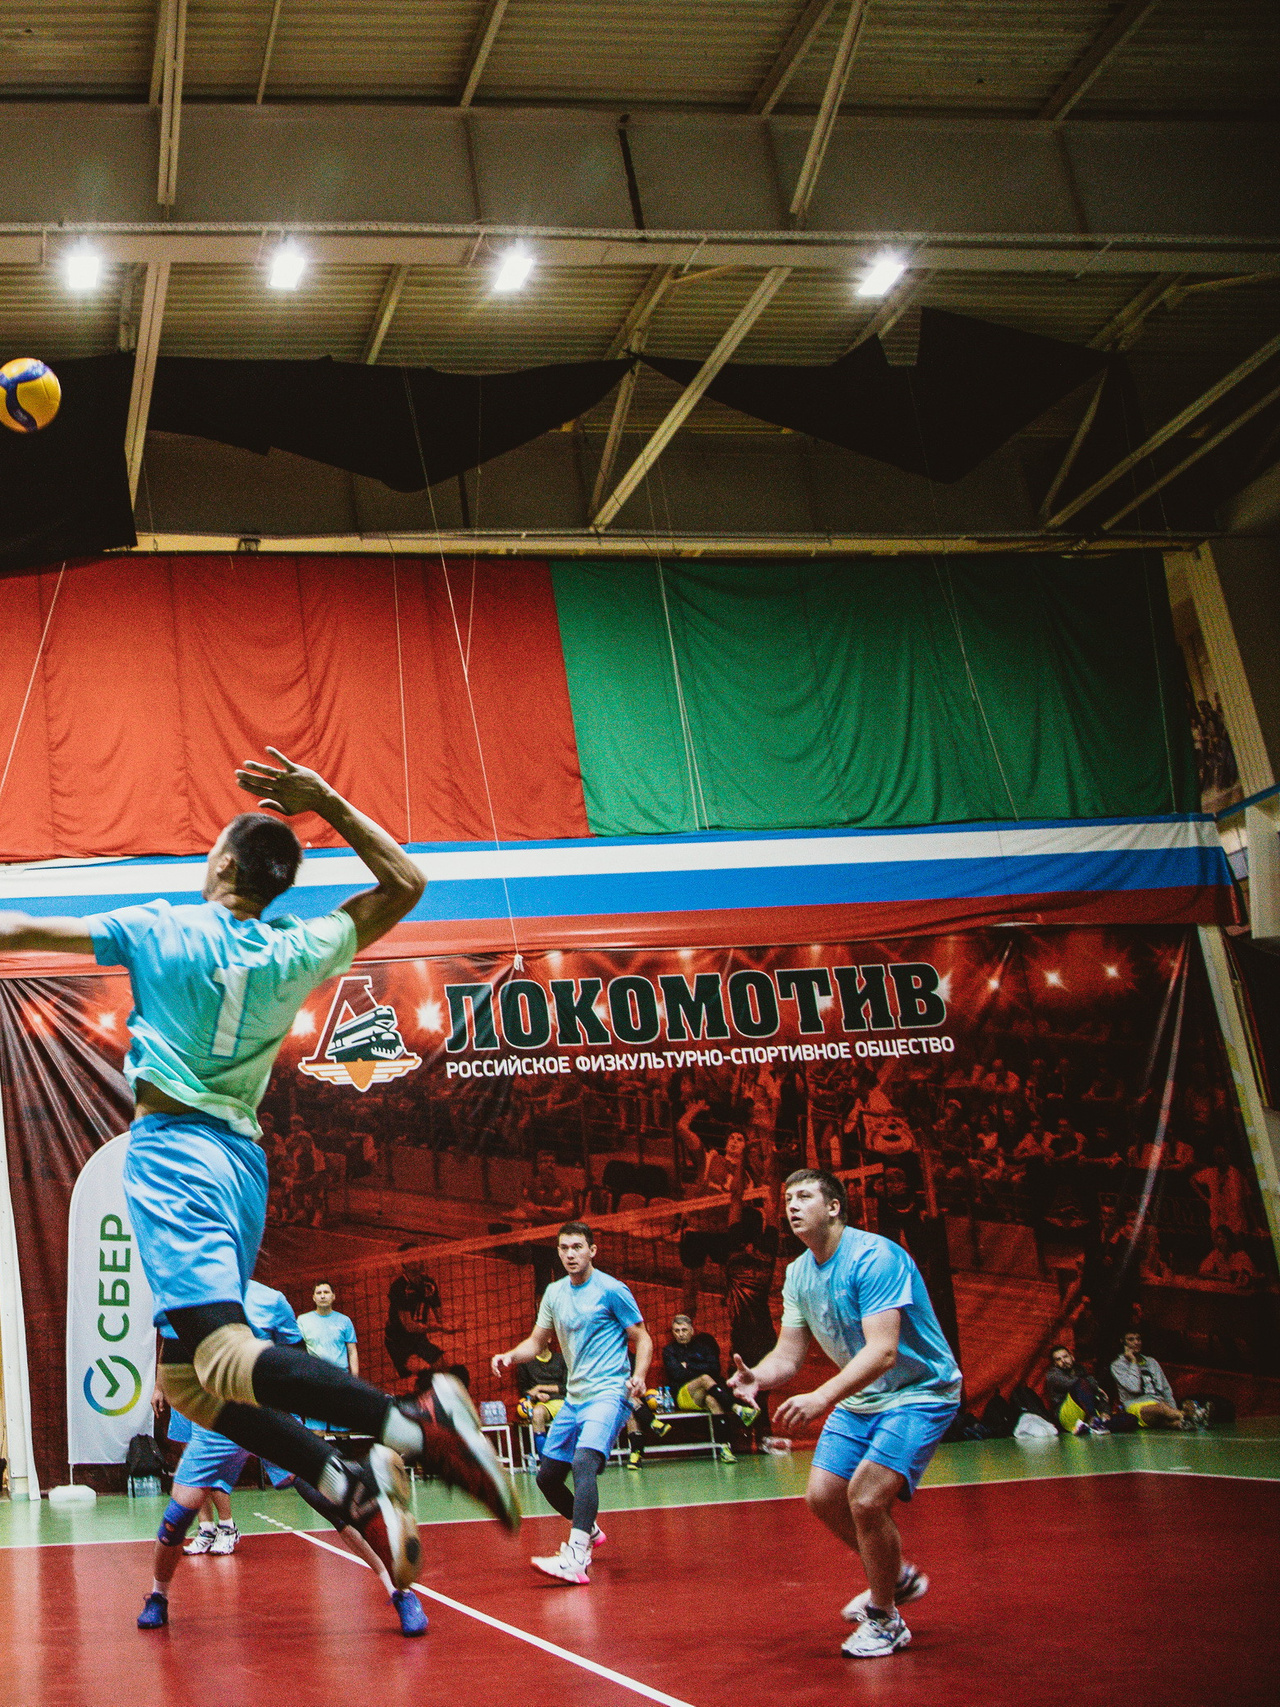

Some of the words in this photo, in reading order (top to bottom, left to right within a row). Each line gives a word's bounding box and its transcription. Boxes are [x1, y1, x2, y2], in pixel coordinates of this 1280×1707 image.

[211, 964, 251, 1058] 1
[444, 961, 947, 1053] ЛОКОМОТИВ
[446, 1055, 571, 1079] РОССИЙСКОЕ
[575, 1041, 851, 1073] ФИЗКУЛЬТУРНО-СПОРТИВНОЕ
[855, 1036, 955, 1059] ОБЩЕСТВО
[97, 1213, 131, 1342] СБЕР
